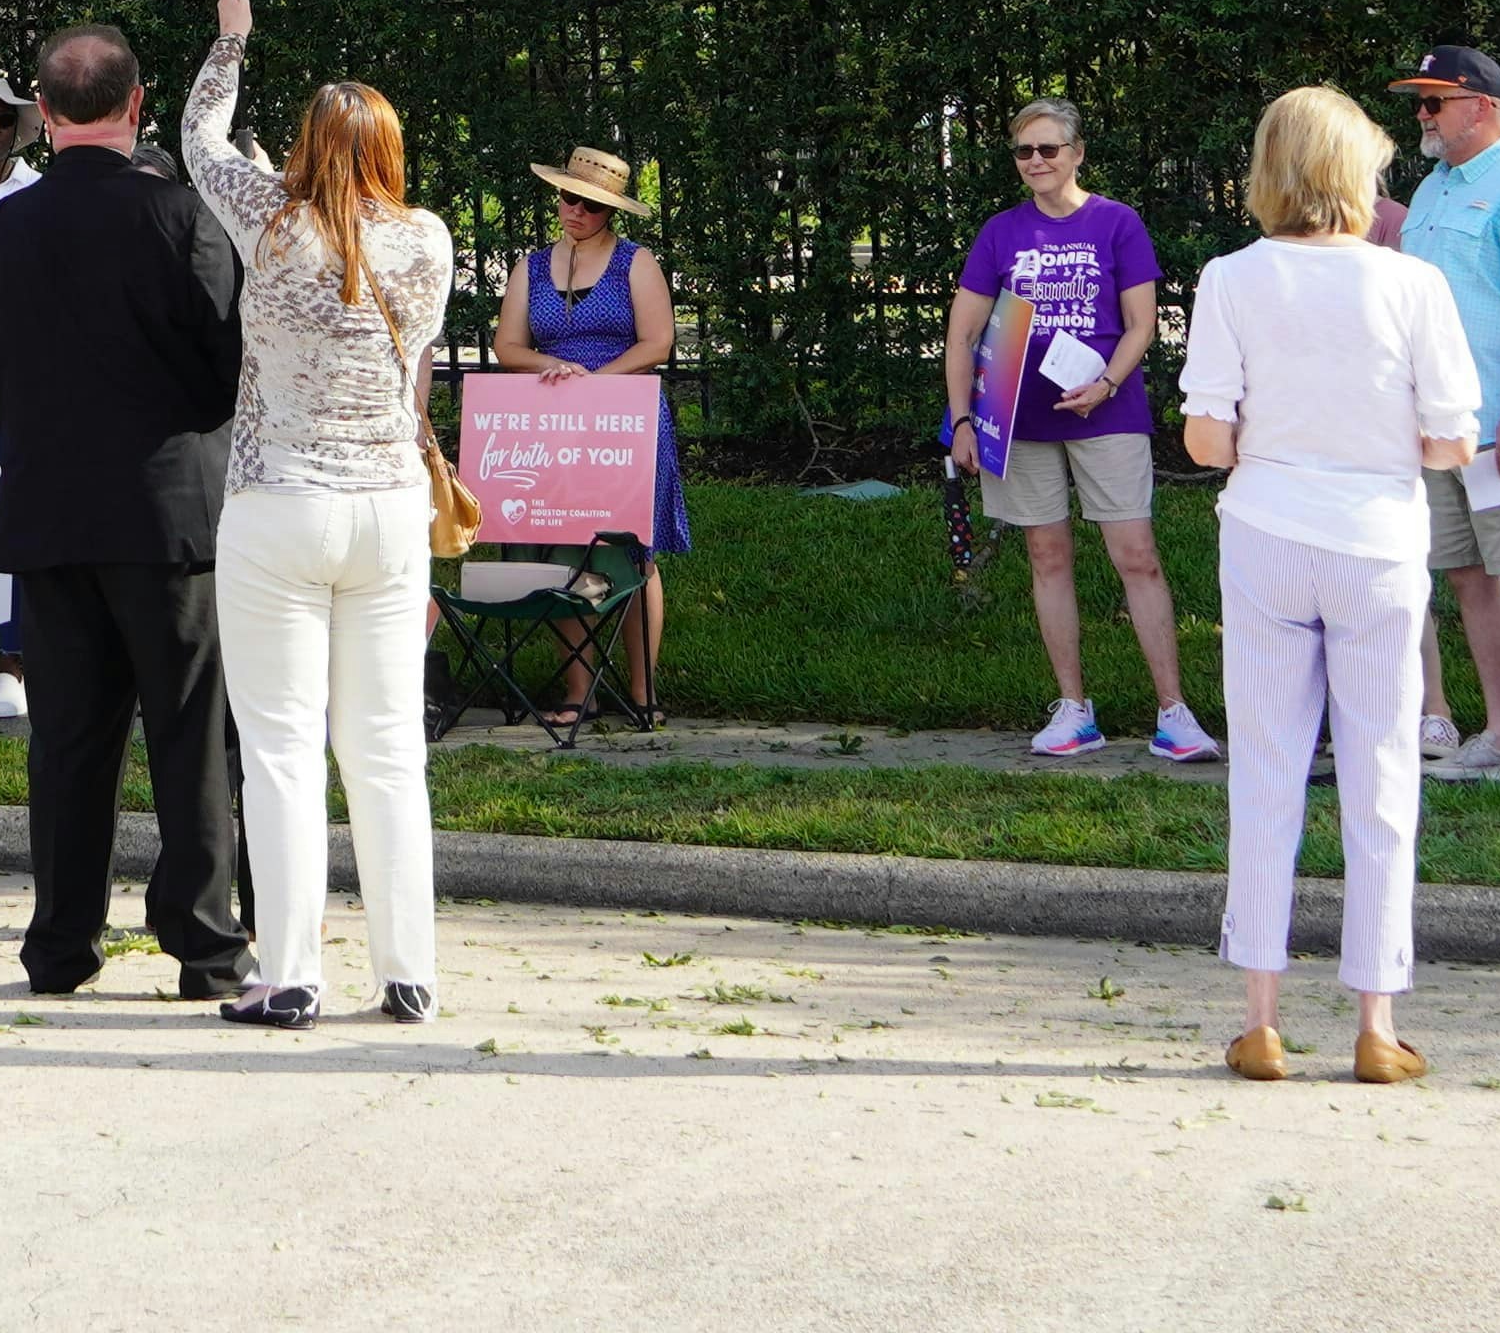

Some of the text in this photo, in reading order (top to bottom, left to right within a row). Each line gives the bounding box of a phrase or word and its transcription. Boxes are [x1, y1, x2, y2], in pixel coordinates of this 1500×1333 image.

[1060, 242, 1098, 253] ANNUAL
[1010, 249, 1100, 277] DOMEL
[1033, 314, 1096, 328] EUNION
[473, 412, 645, 432] WE'RE STILL HERE
[479, 432, 633, 481] for both OF YOU!
[531, 509, 612, 518] HOUSTON COALITION
[547, 519, 563, 527] LIFE
